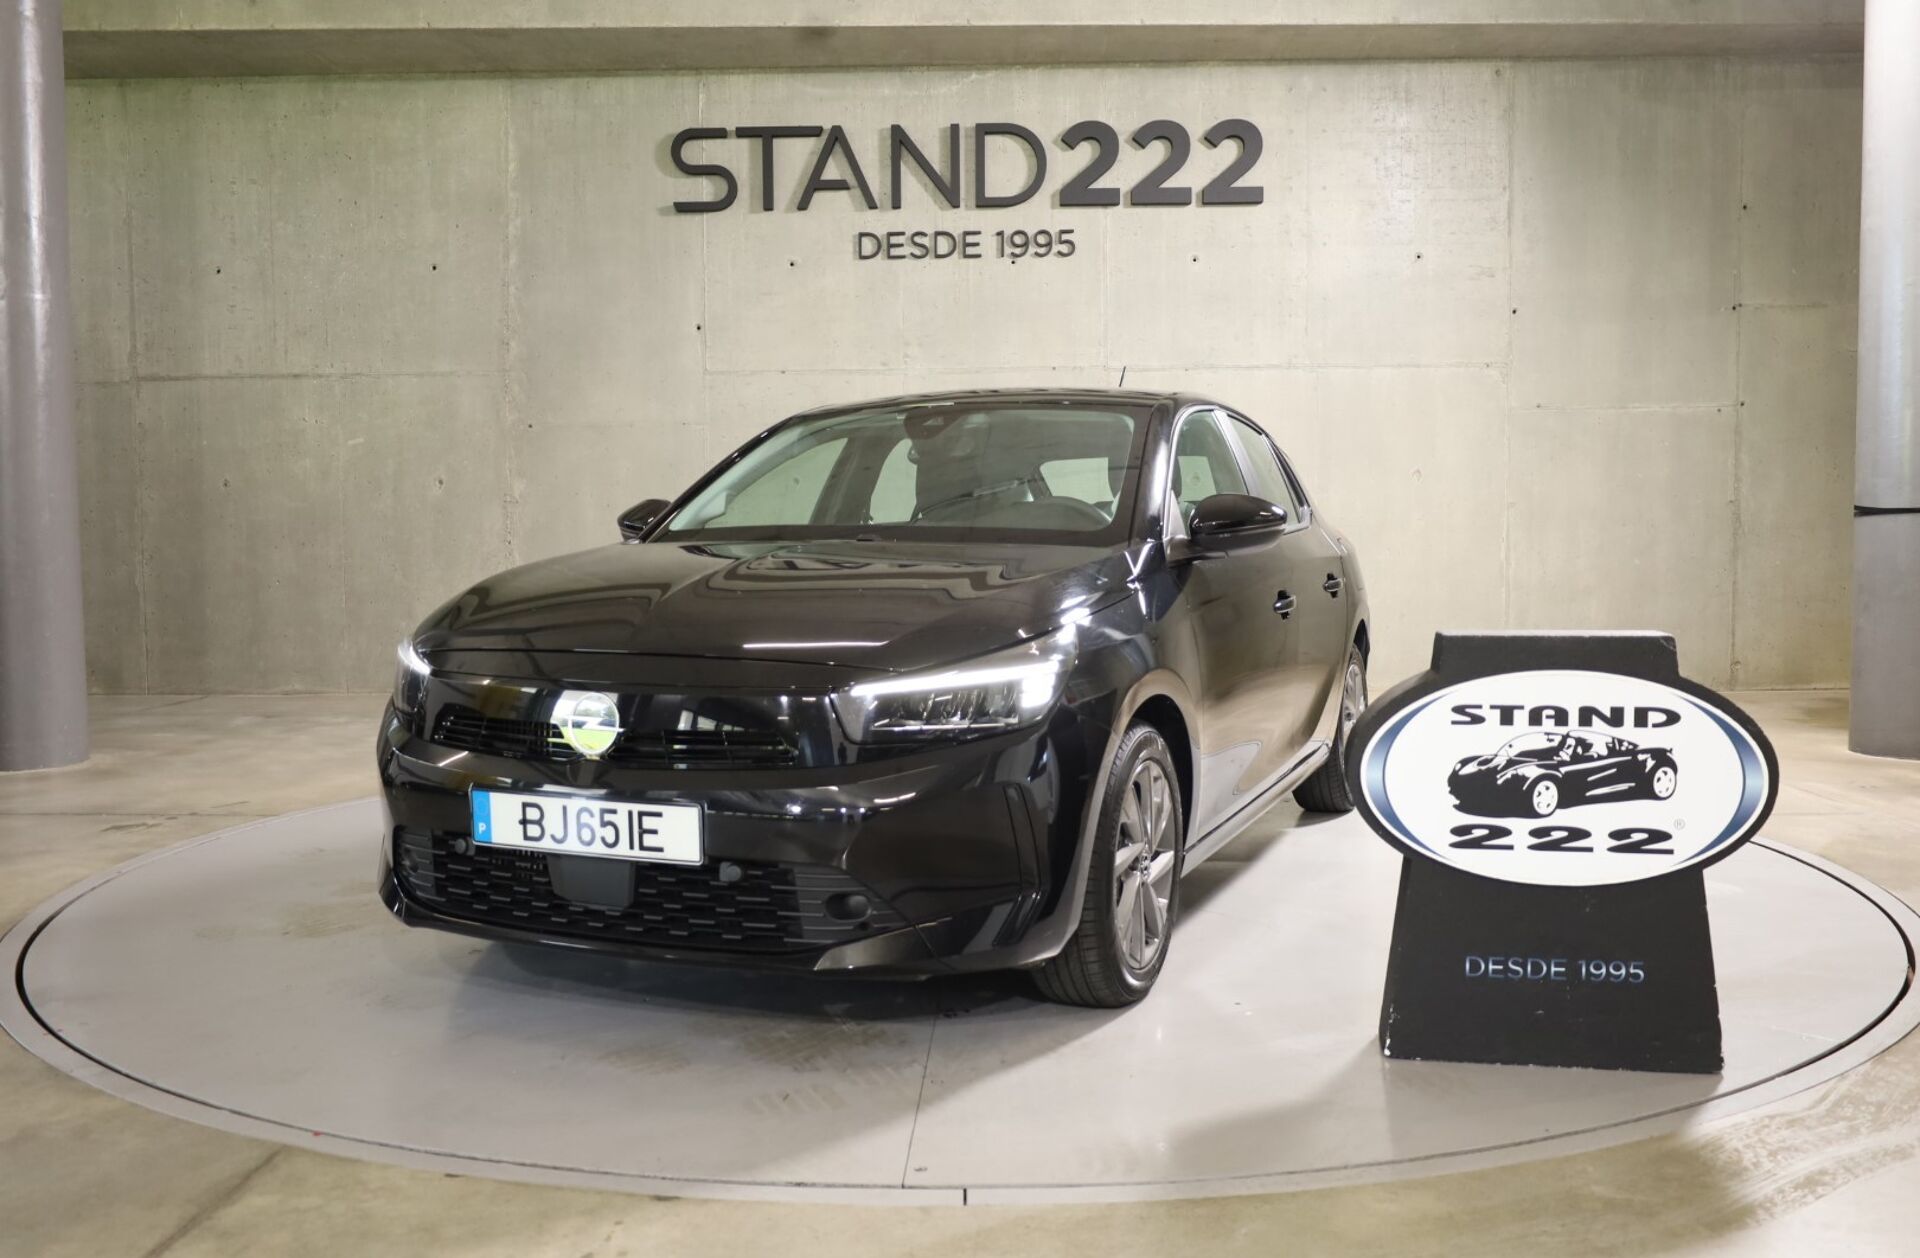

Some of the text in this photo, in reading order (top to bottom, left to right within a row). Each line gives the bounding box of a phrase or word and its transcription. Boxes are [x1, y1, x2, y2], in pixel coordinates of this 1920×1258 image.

[857, 229, 1076, 260] DESDE 1995
[1450, 704, 1682, 729] STAND
[478, 823, 486, 835] P
[1448, 823, 1675, 855] 222
[1465, 955, 1645, 984] DESDE 1995
